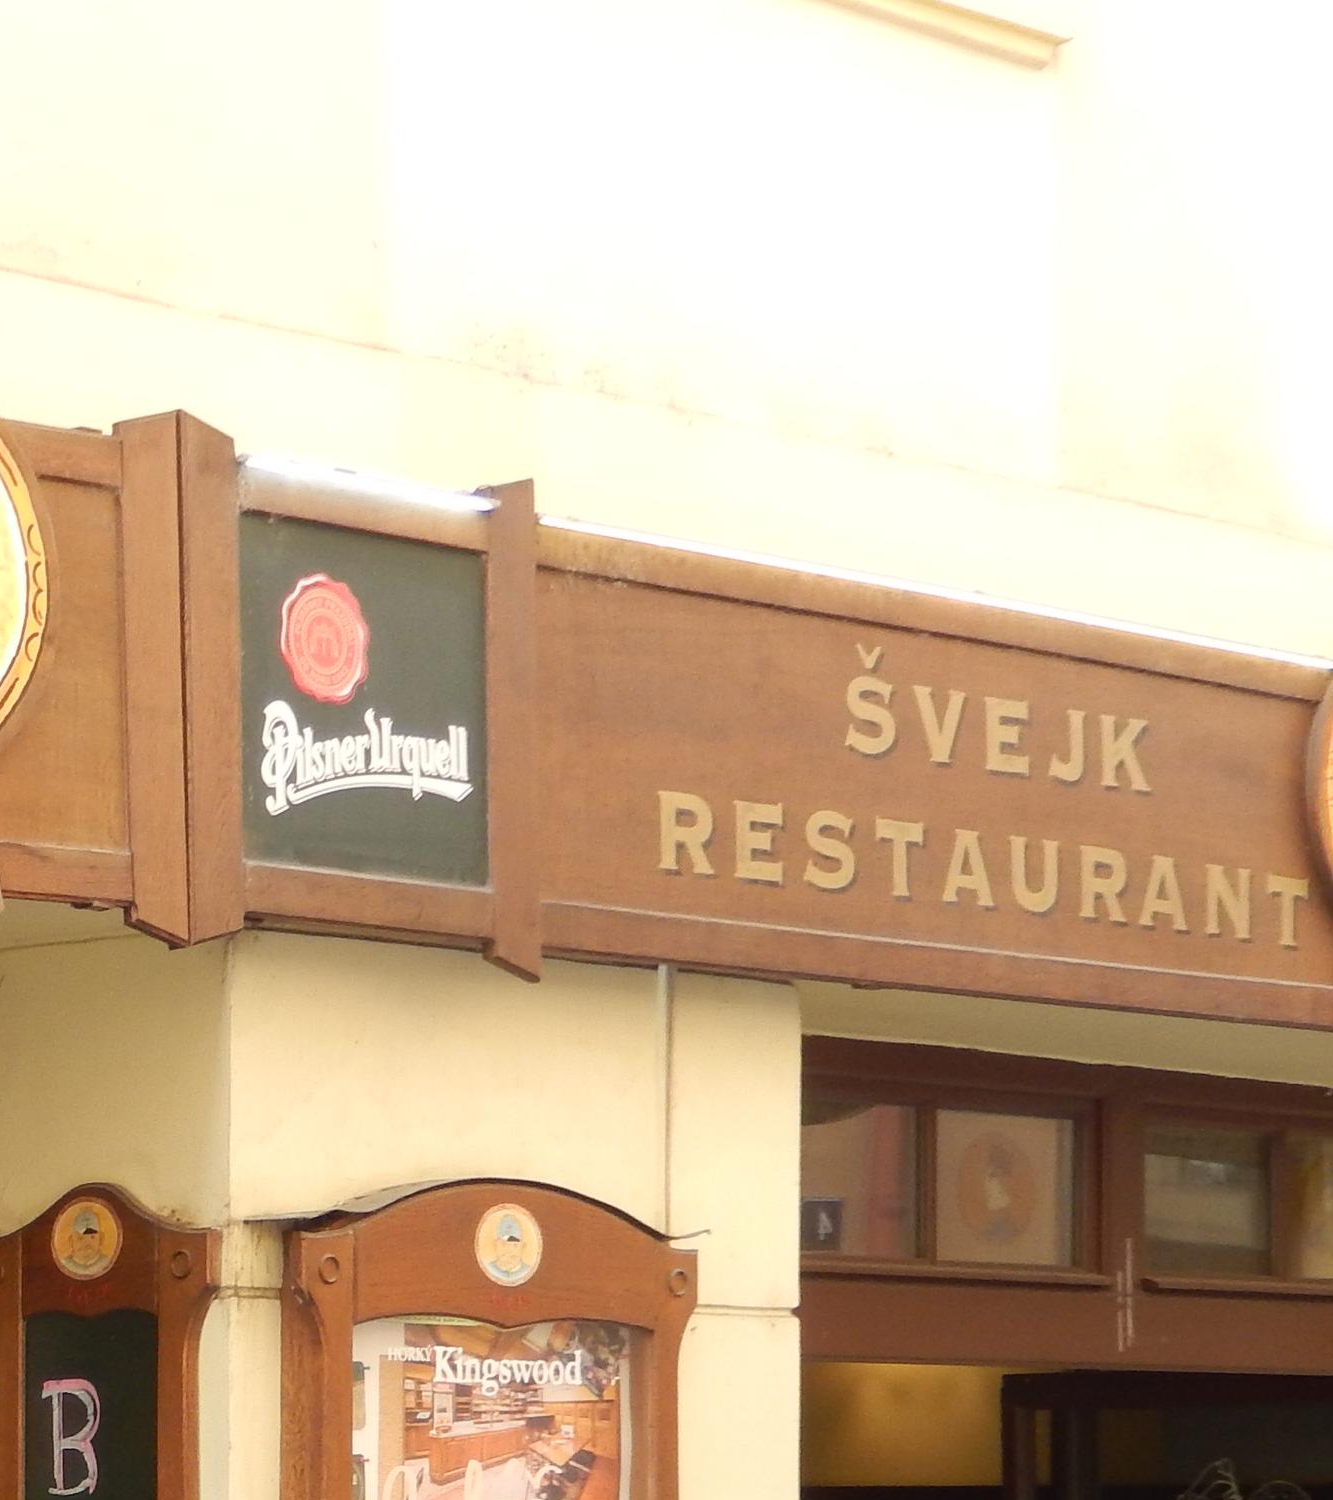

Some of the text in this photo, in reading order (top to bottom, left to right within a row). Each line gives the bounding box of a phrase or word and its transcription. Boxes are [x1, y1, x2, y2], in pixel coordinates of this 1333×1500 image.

[260, 700, 470, 816] Pilsner Urquell
[844, 643, 1153, 793] ŠVEJK
[655, 789, 1310, 949] RESTAURANT
[387, 1344, 583, 1396] HORKÝ Kingswood
